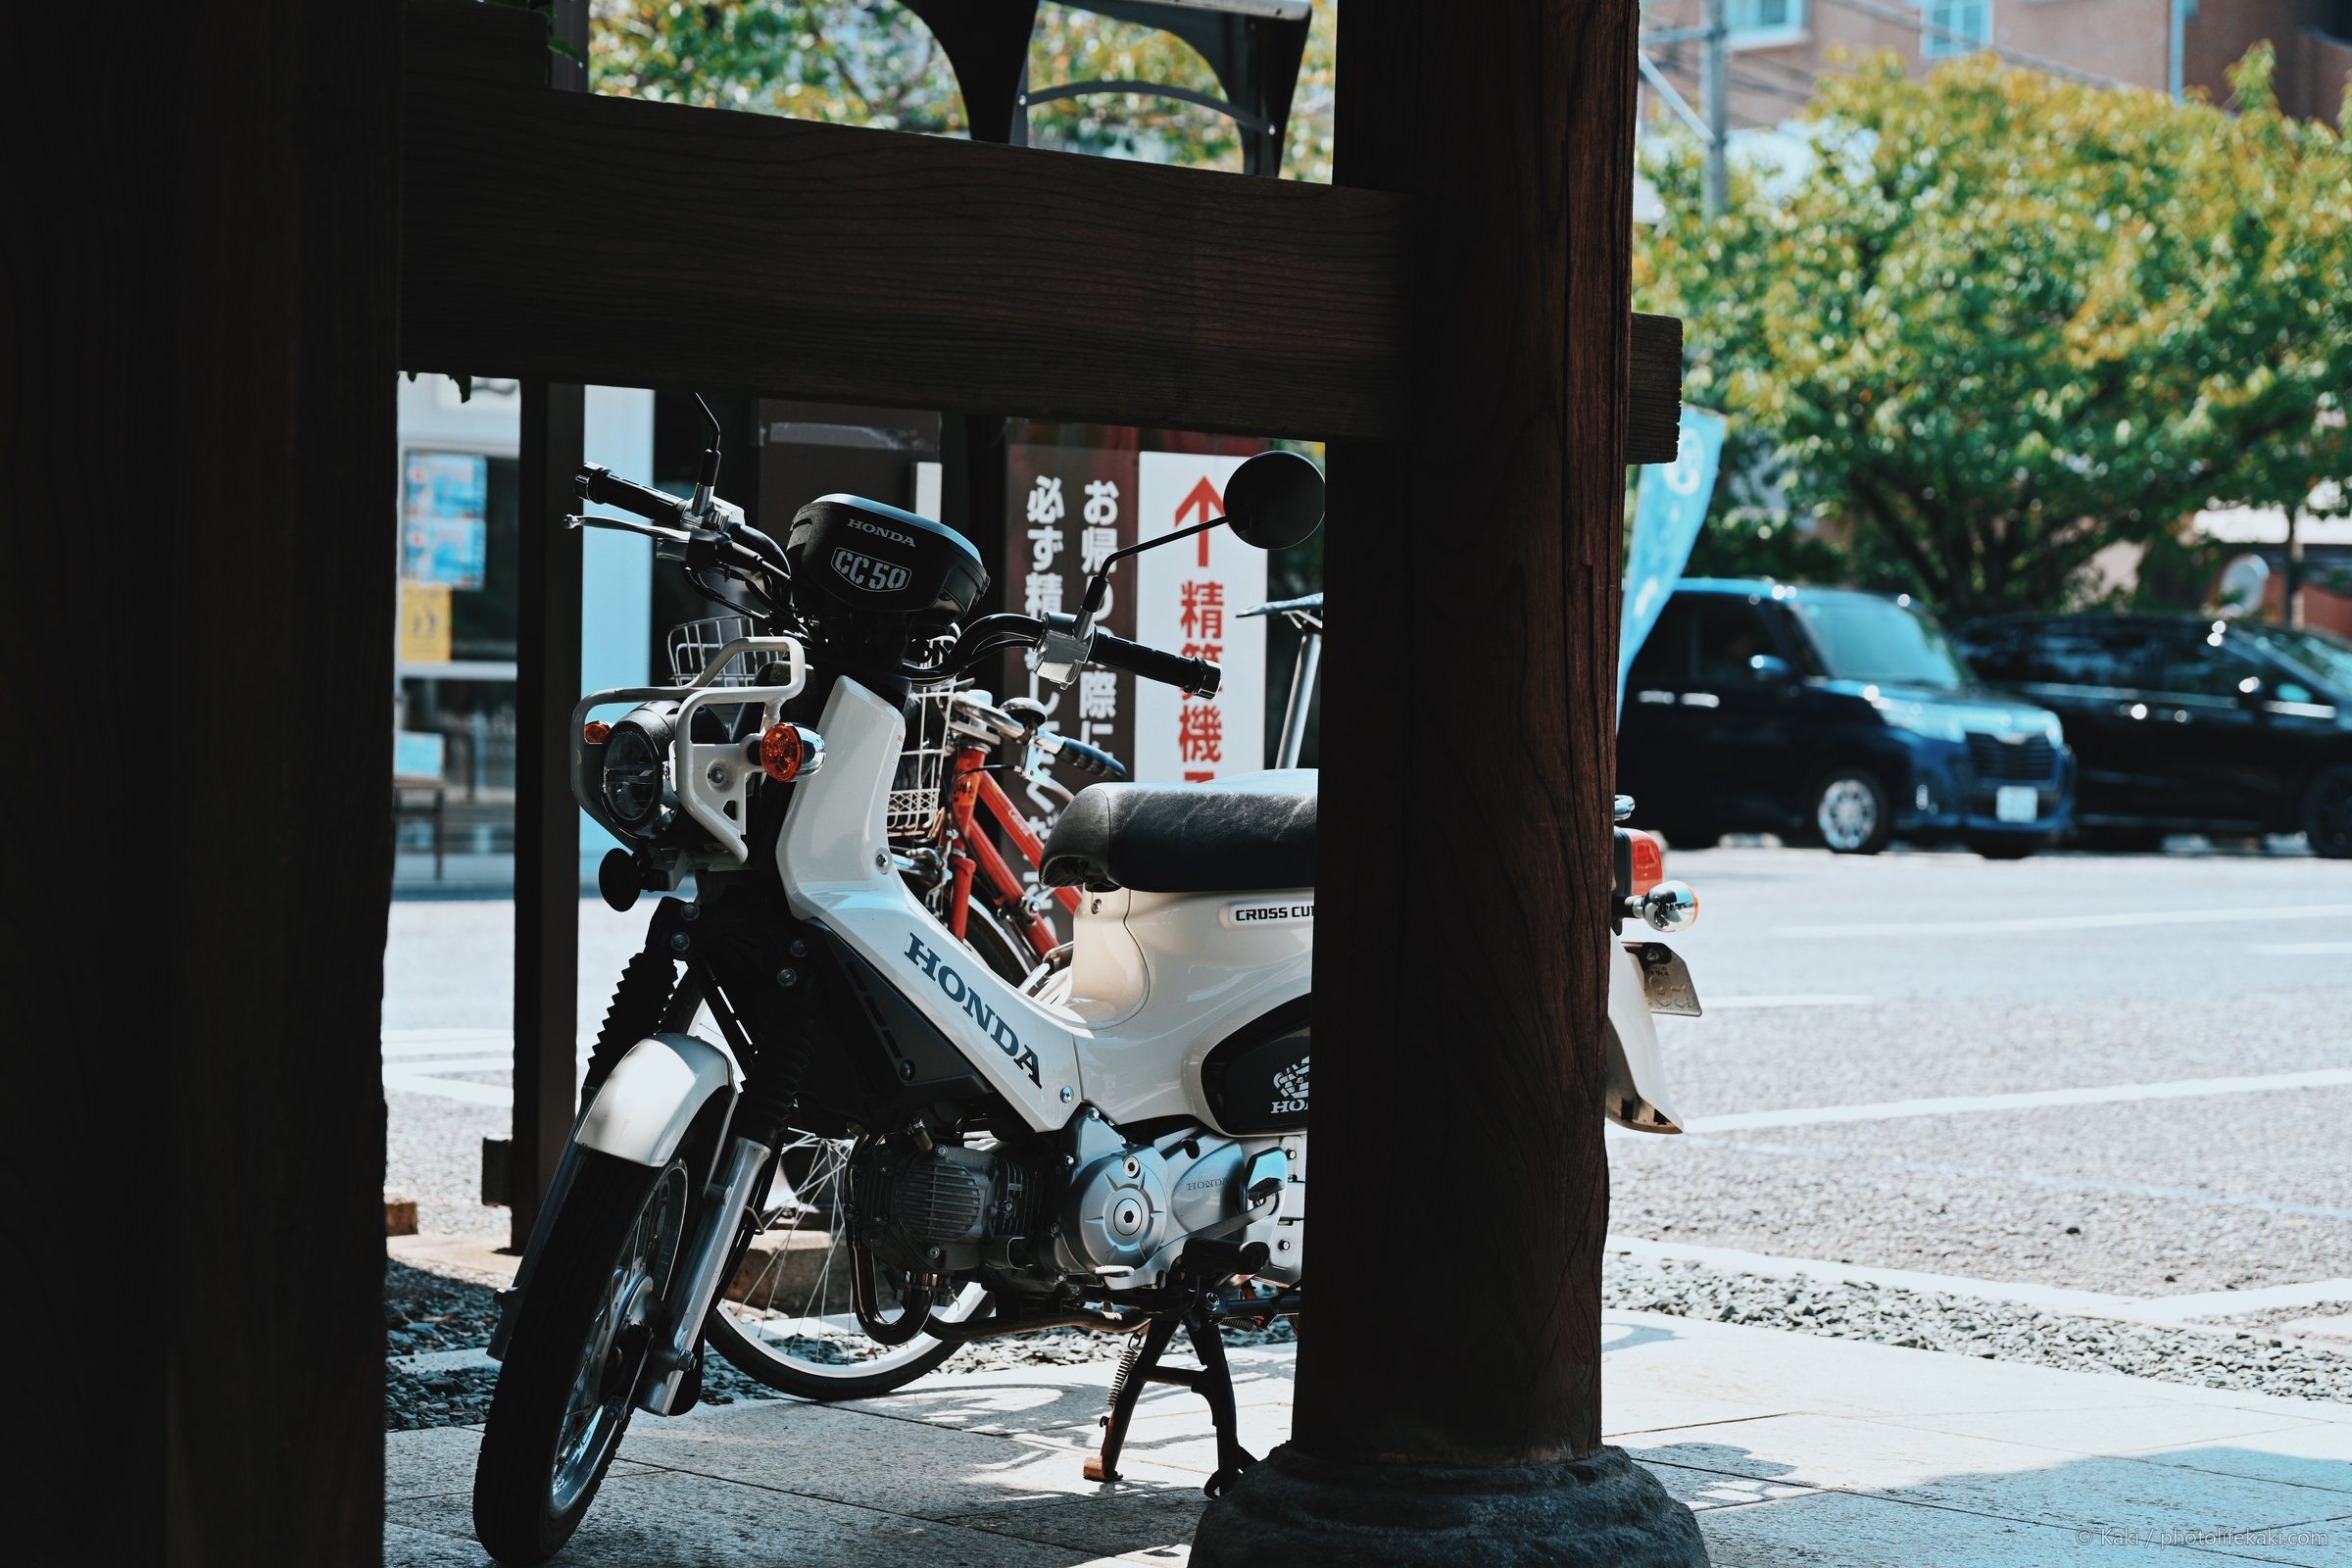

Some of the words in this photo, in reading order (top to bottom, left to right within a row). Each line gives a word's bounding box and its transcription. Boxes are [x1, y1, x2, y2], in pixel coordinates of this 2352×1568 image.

[847, 518, 916, 548] HONDA
[1236, 907, 1288, 921] CROSS
[904, 932, 1043, 1090] HONDA
[1271, 1099, 1308, 1113] HO
